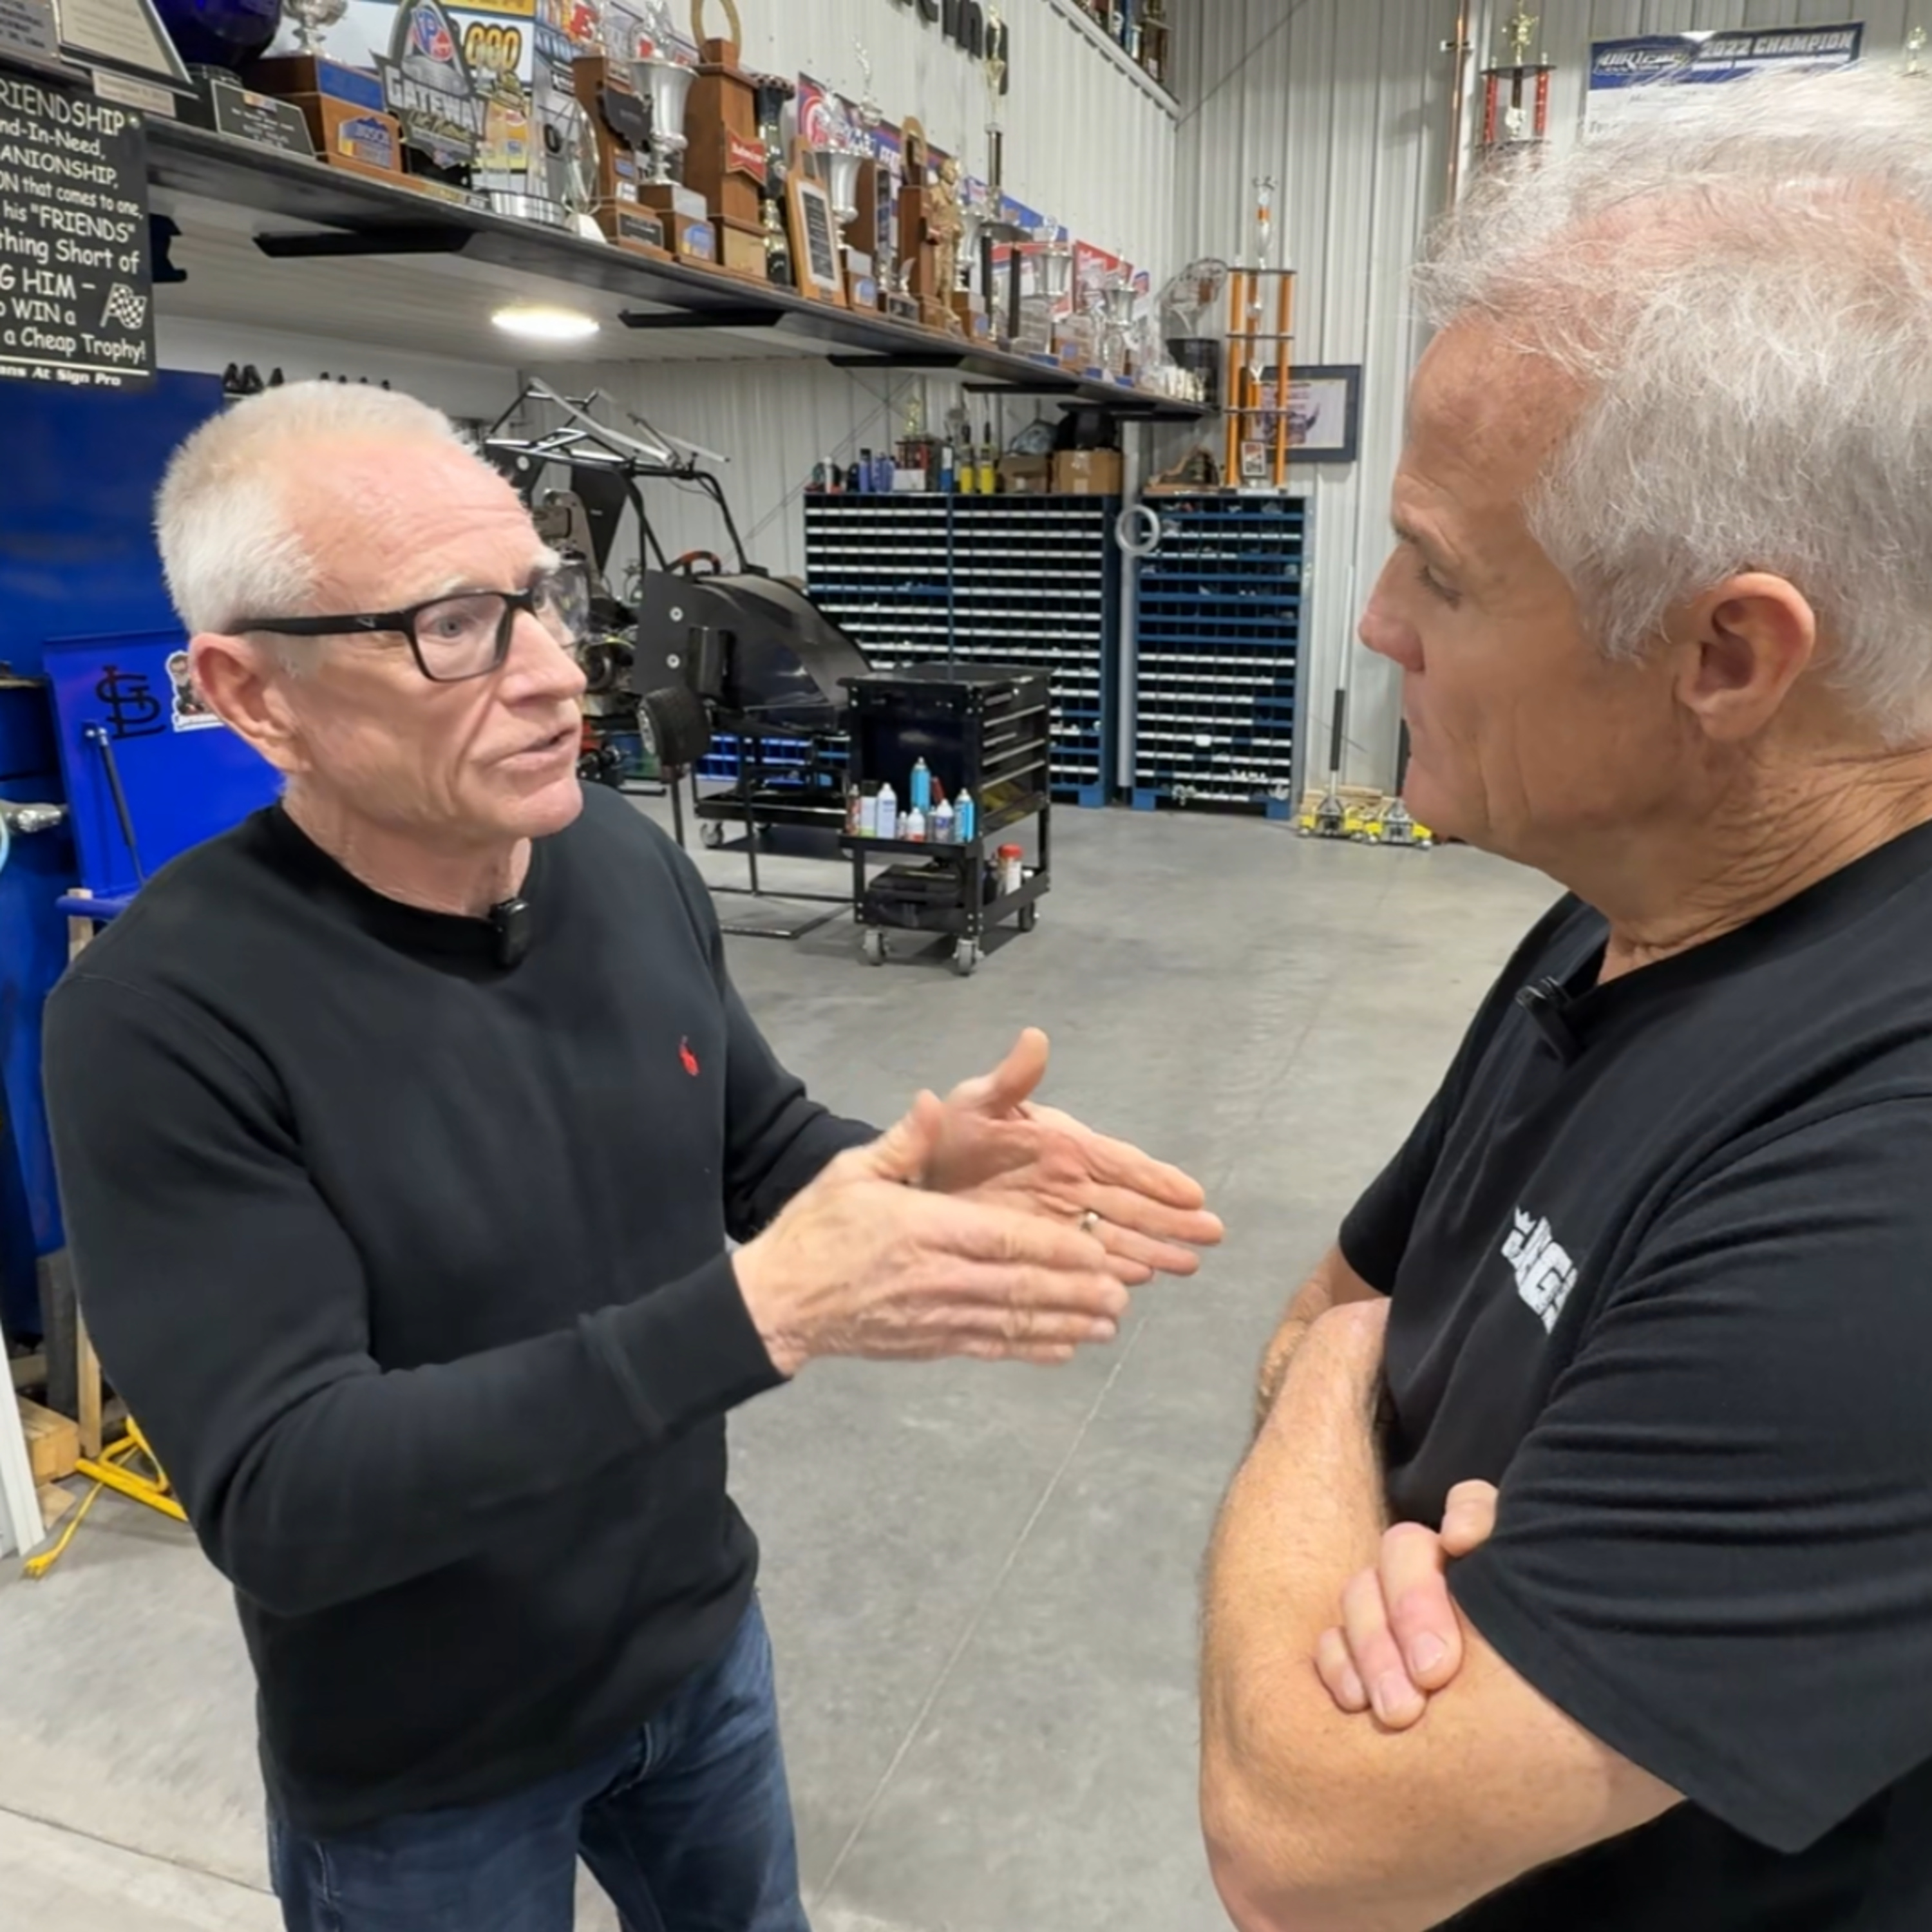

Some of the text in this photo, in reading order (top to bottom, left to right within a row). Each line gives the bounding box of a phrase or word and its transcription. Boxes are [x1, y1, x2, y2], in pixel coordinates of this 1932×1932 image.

[1699, 30, 1855, 59] 2022 CHAMPION
[385, 65, 487, 137] GATEWAY
[3, 199, 28, 222] his
[22, 175, 53, 198] that
[55, 186, 97, 208] comes
[99, 194, 115, 211] to
[116, 200, 144, 220] one,
[55, 238, 113, 269] Short
[118, 250, 140, 275] of
[0, 263, 16, 290] G
[22, 267, 77, 301] HIM
[10, 296, 62, 324] WIN
[64, 310, 77, 327] a
[3, 327, 146, 366] a Cheap Trophy!
[32, 366, 52, 380] At
[56, 369, 90, 385] Sign
[95, 373, 122, 386] Pro
